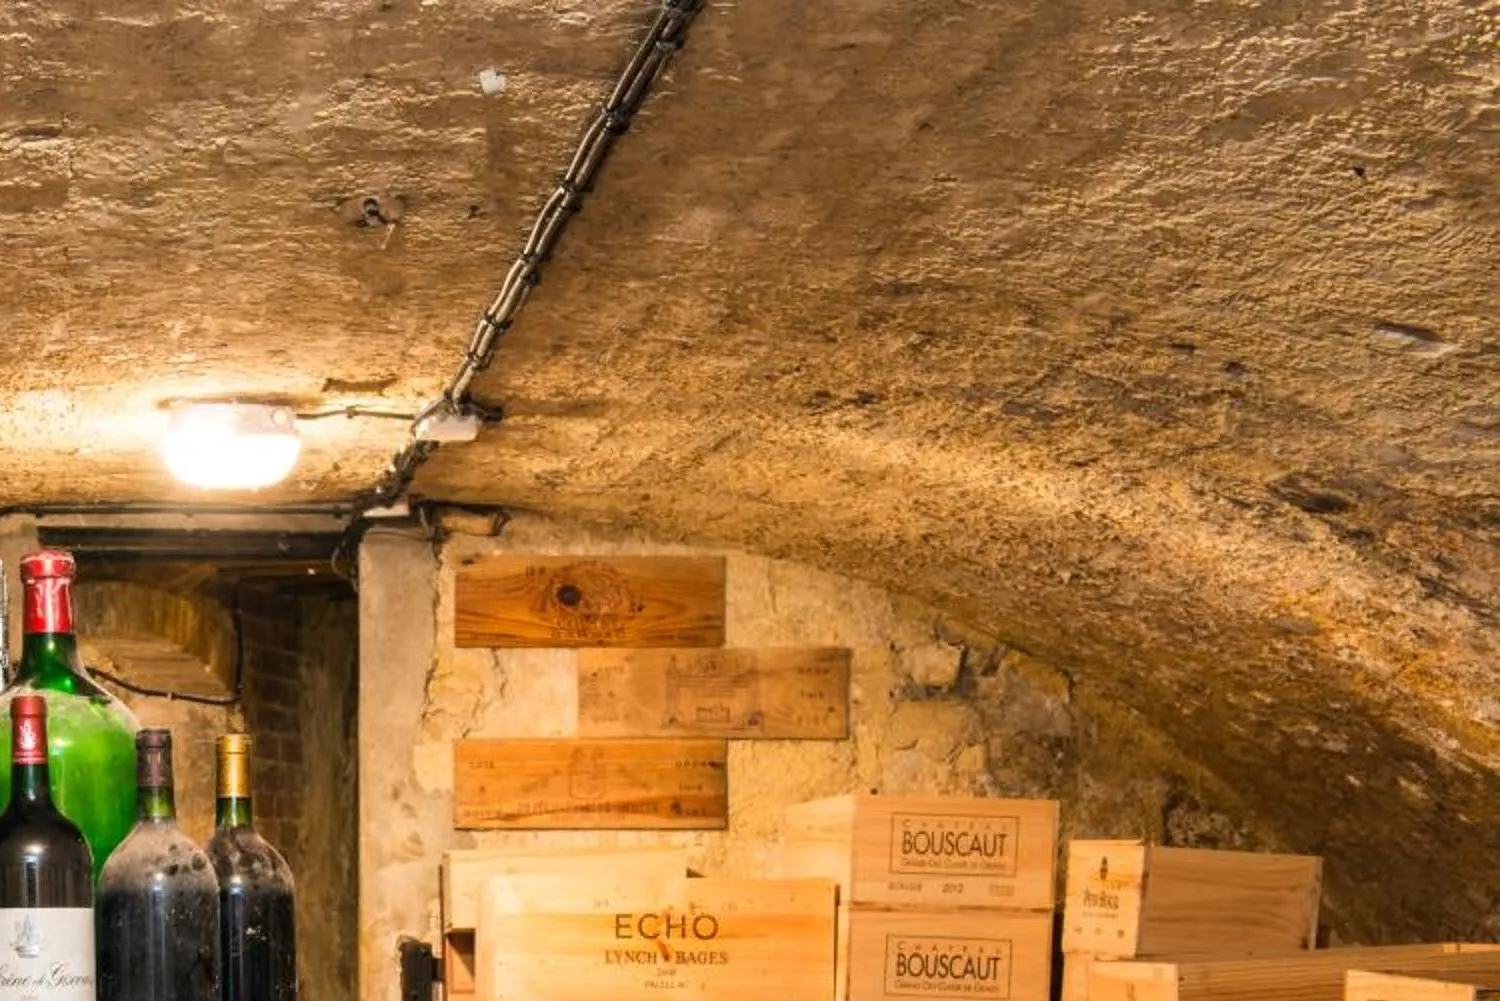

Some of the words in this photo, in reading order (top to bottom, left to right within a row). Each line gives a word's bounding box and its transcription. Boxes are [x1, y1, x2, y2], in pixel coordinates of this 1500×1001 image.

[902, 830, 1007, 857] BOUSCAUT
[615, 913, 718, 940] ECHO
[605, 950, 657, 965] LYNCH
[675, 951, 729, 965] BAGES
[896, 952, 1002, 980] BOUSCAUT
